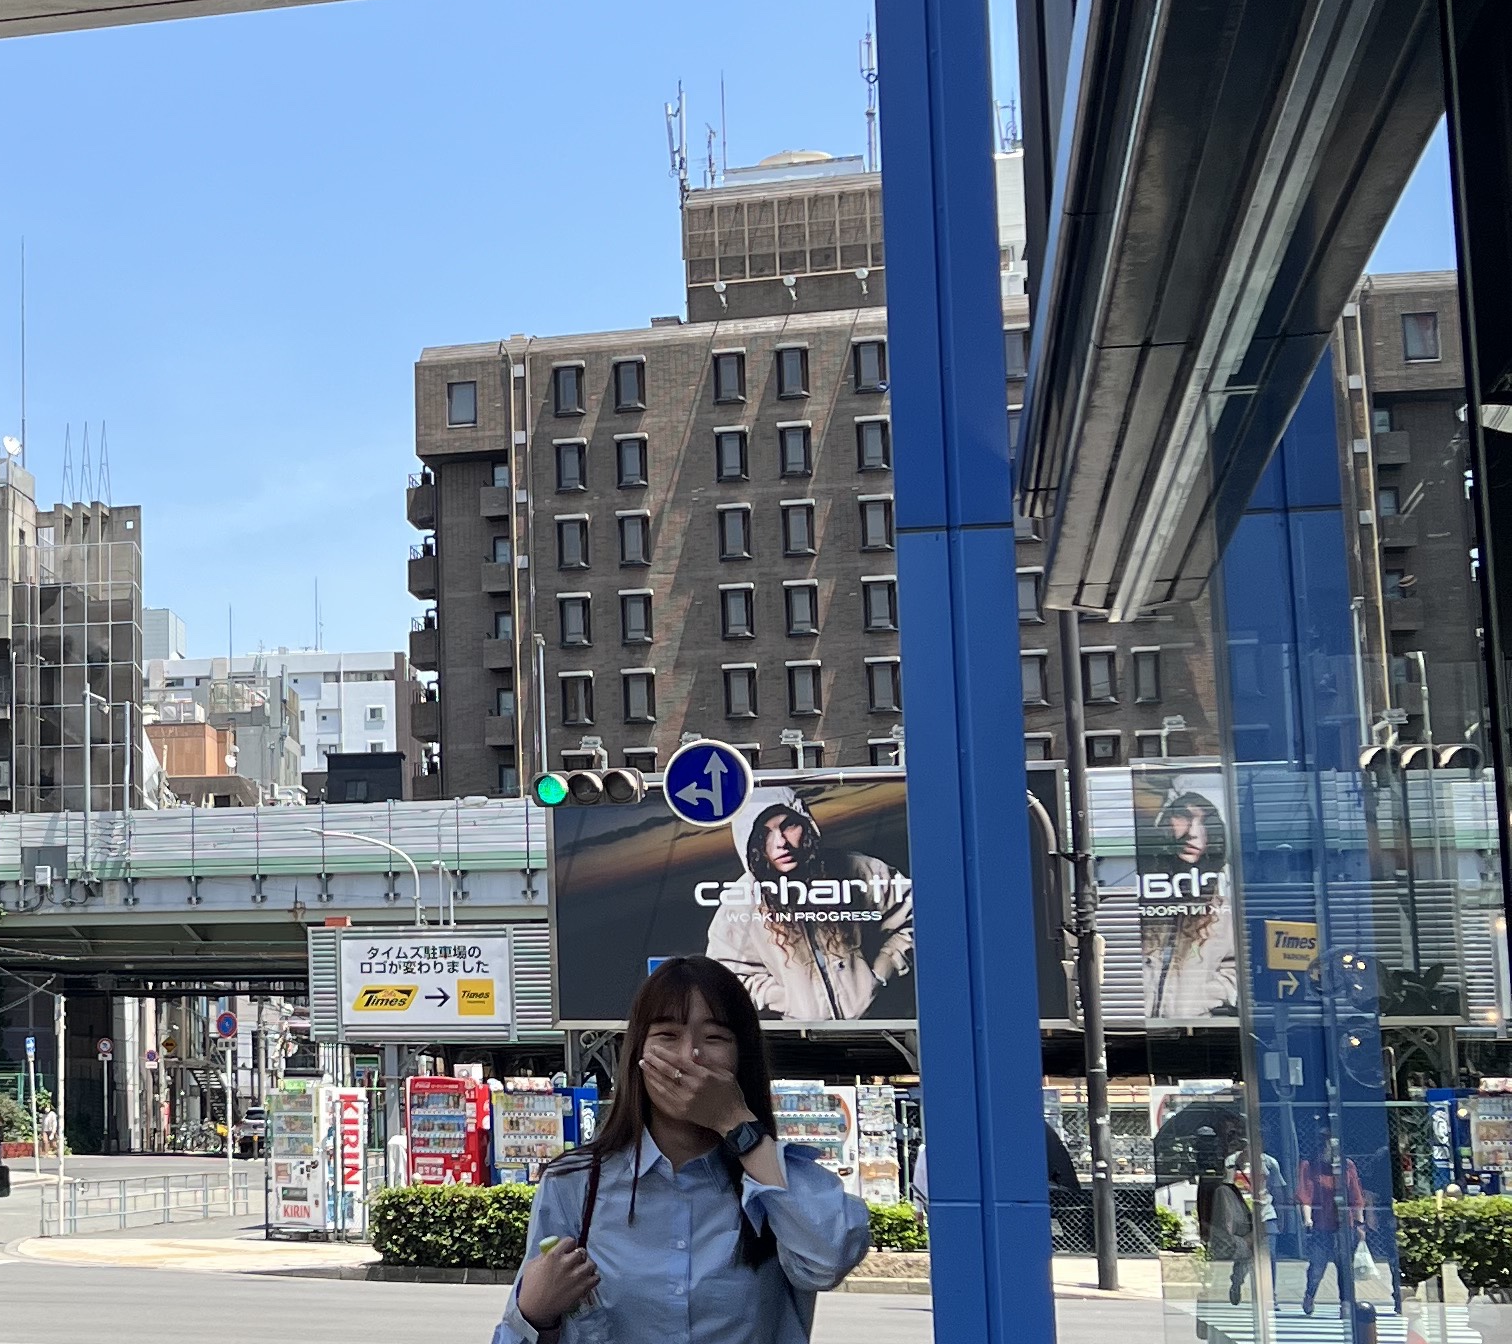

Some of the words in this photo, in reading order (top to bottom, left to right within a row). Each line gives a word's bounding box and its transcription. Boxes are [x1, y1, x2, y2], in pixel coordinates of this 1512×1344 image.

[694, 873, 913, 907] carhartt
[726, 912, 773, 923] WORK
[775, 912, 792, 923] IN
[794, 910, 883, 923] PROGRESS
[1274, 930, 1317, 950] Times
[367, 945, 482, 960] タイムズ駐車場の
[360, 960, 490, 975] ロゴが変わりました
[362, 988, 414, 1008] Times
[461, 989, 490, 999] Times
[339, 1093, 360, 1185] KIRIN
[283, 1204, 311, 1219] KIRIN
